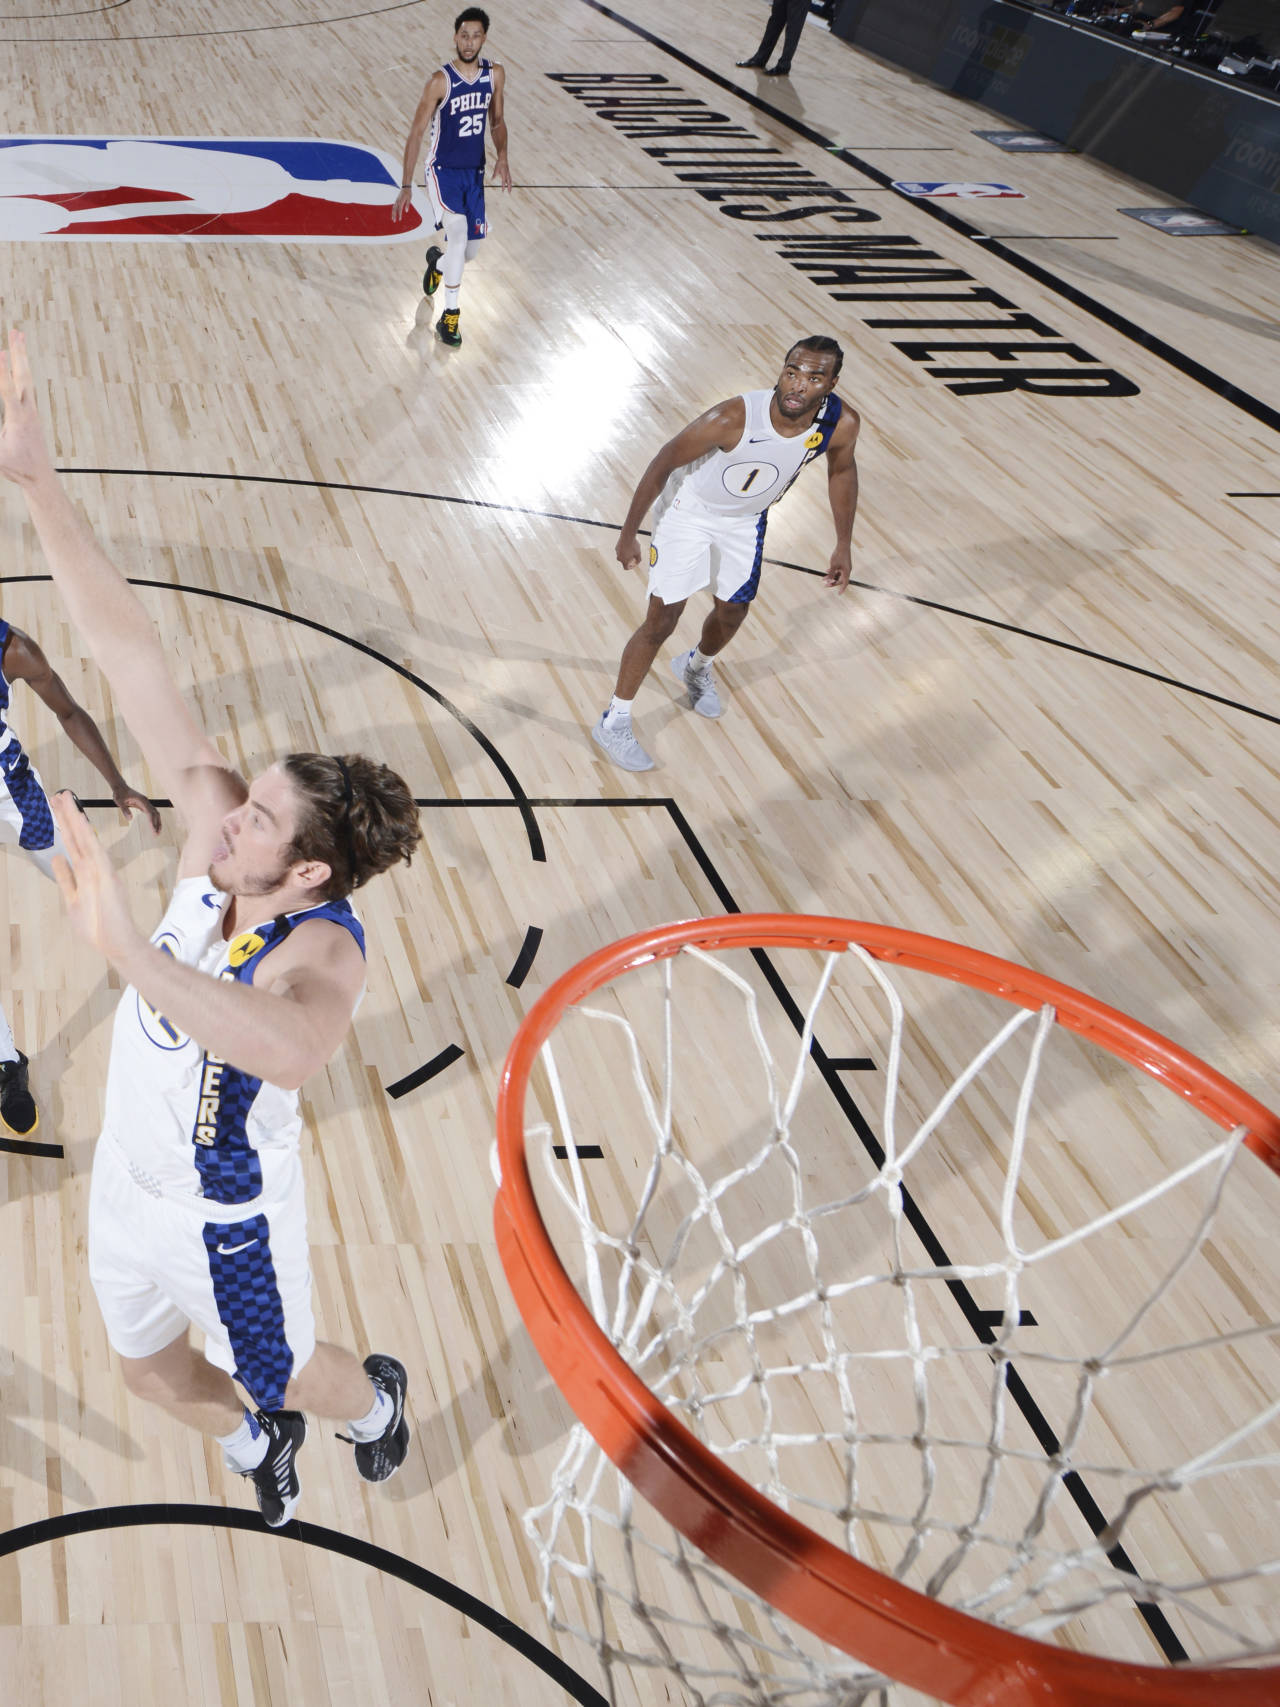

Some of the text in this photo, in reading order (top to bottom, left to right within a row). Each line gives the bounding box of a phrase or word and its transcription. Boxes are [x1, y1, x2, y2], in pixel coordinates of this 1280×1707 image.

[458, 114, 484, 137] 25
[544, 73, 1141, 397] BLACK LIVES MATTER
[741, 468, 760, 492] 1
